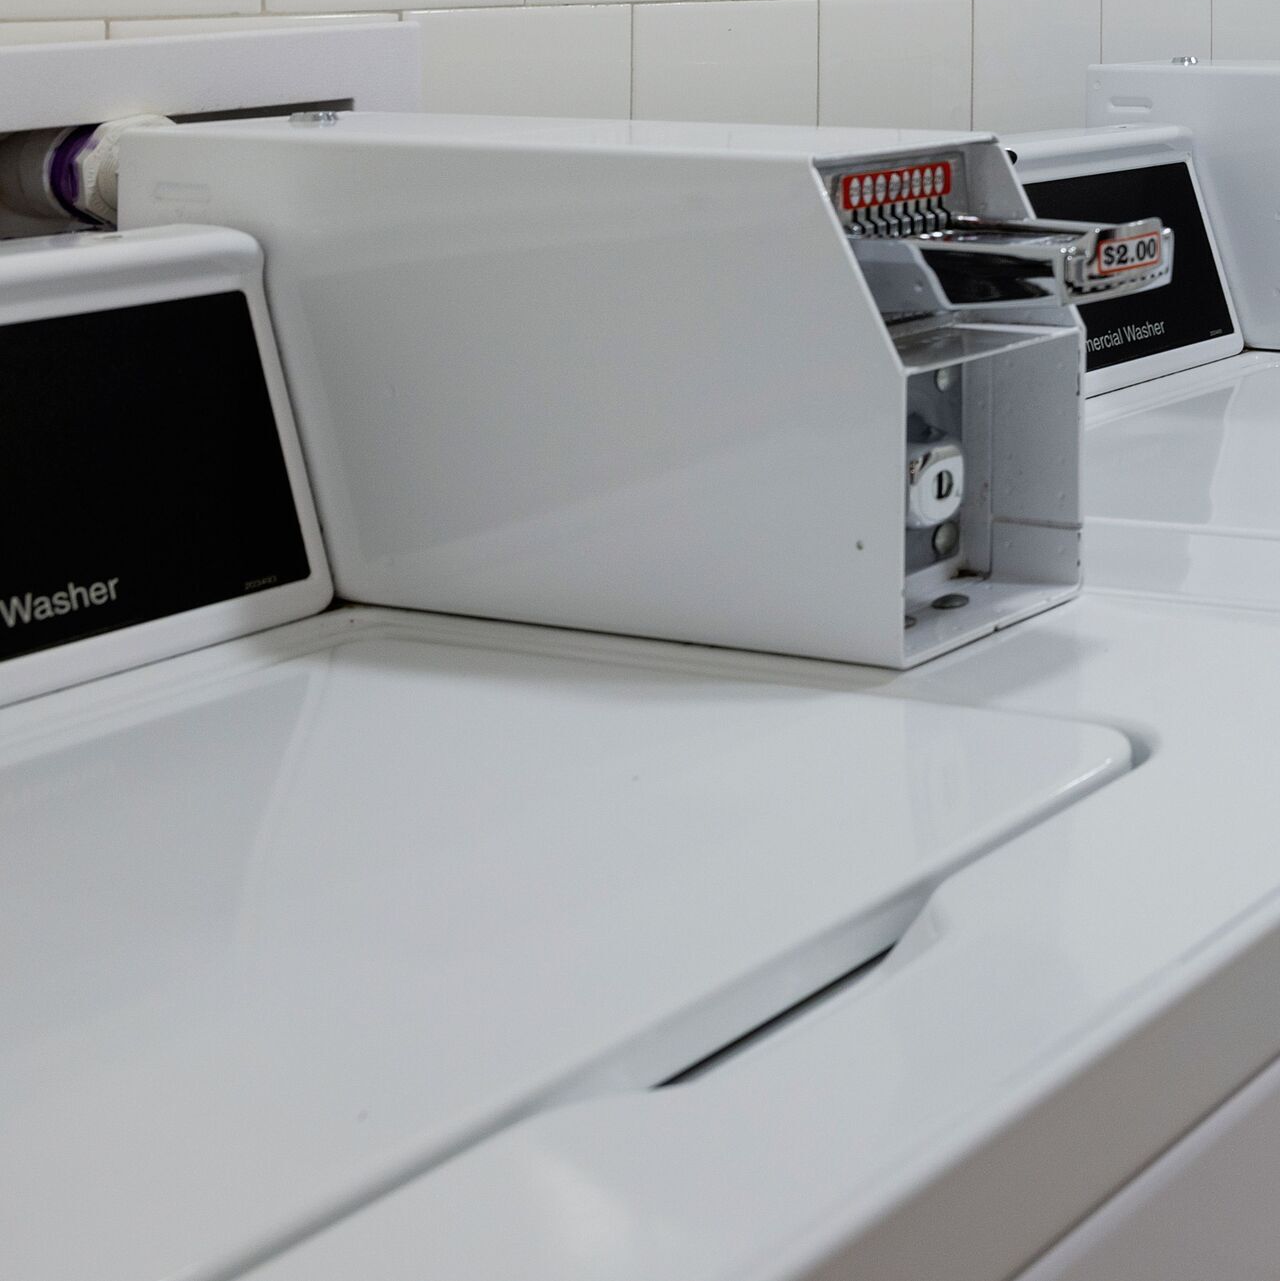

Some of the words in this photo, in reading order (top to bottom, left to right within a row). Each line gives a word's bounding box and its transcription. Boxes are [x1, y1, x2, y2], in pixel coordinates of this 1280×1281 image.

[1103, 238, 1156, 266] $2.00
[1123, 320, 1166, 343] Washer
[0, 577, 119, 629] Washer
